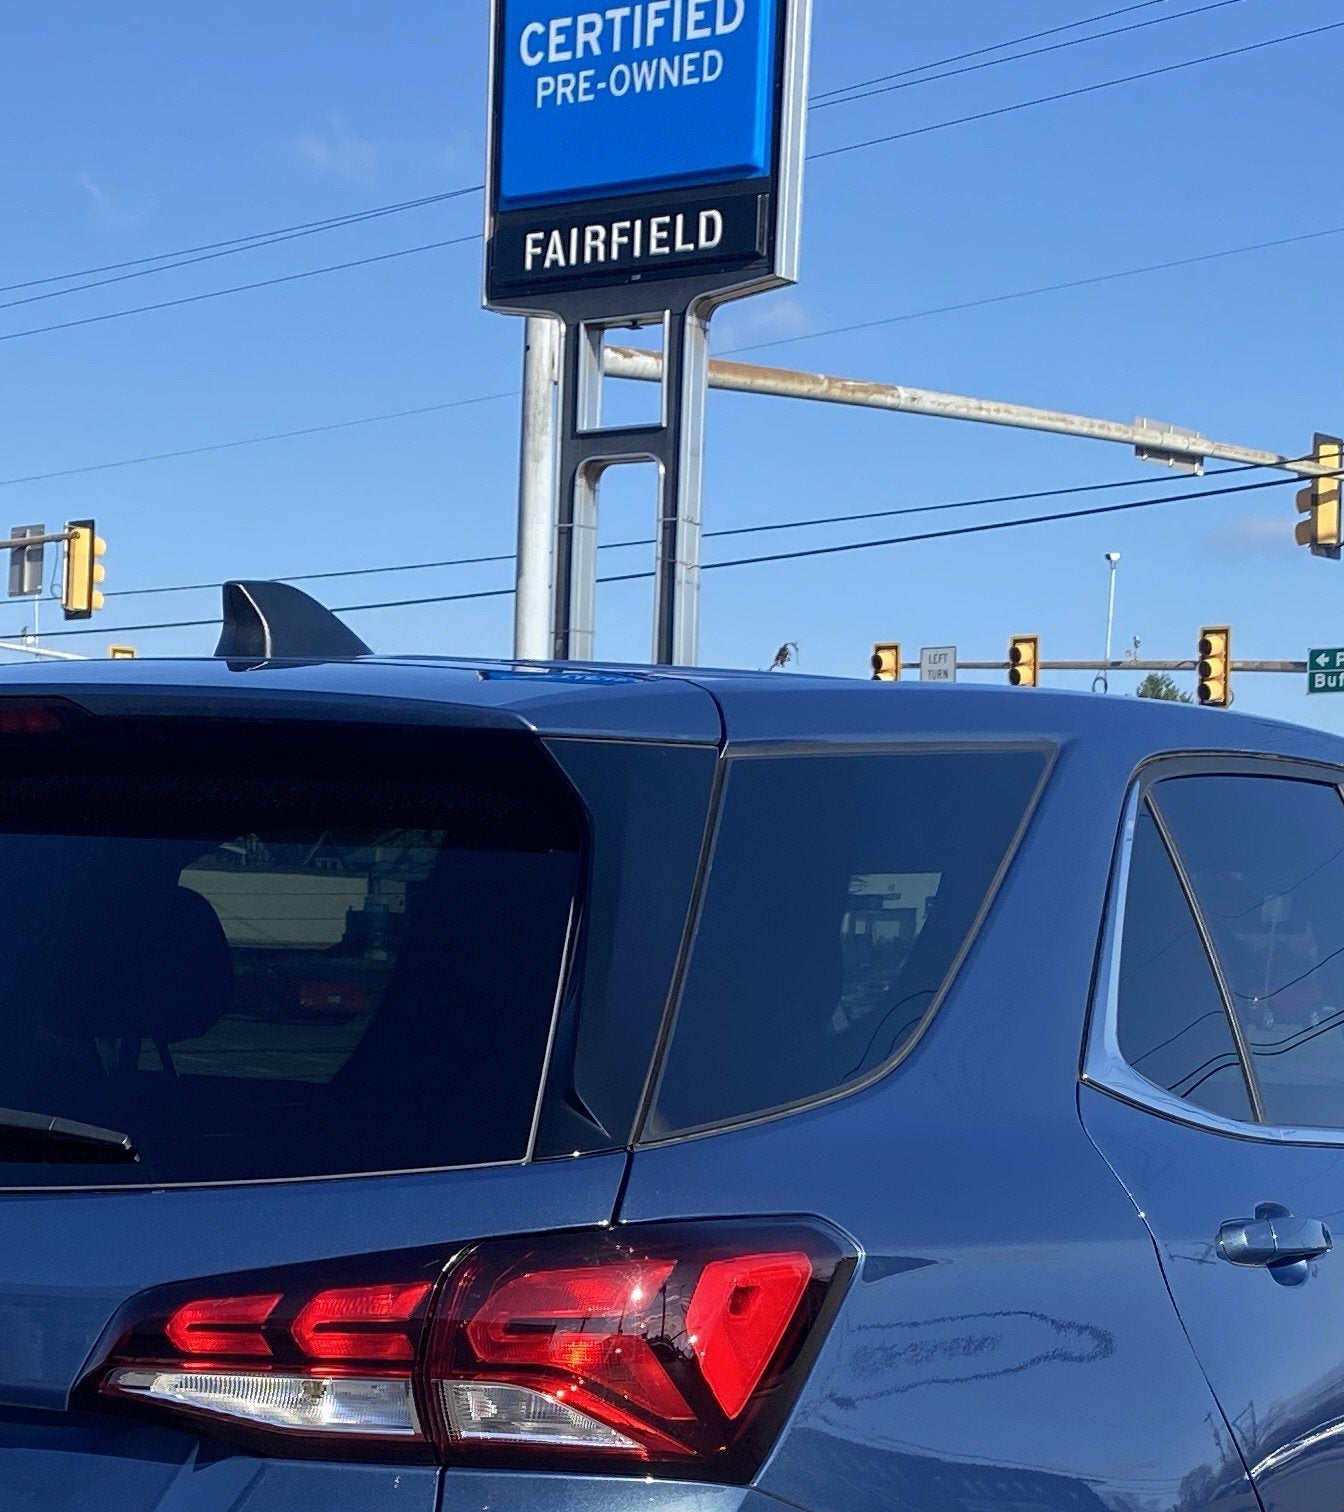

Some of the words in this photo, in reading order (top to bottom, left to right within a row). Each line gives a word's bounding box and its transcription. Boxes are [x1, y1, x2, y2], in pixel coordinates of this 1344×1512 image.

[519, 0, 746, 67] CERTIFIED
[535, 49, 724, 109] PRE-OWNED
[524, 209, 724, 272] FAIRFIELD
[928, 653, 948, 665] LEFT
